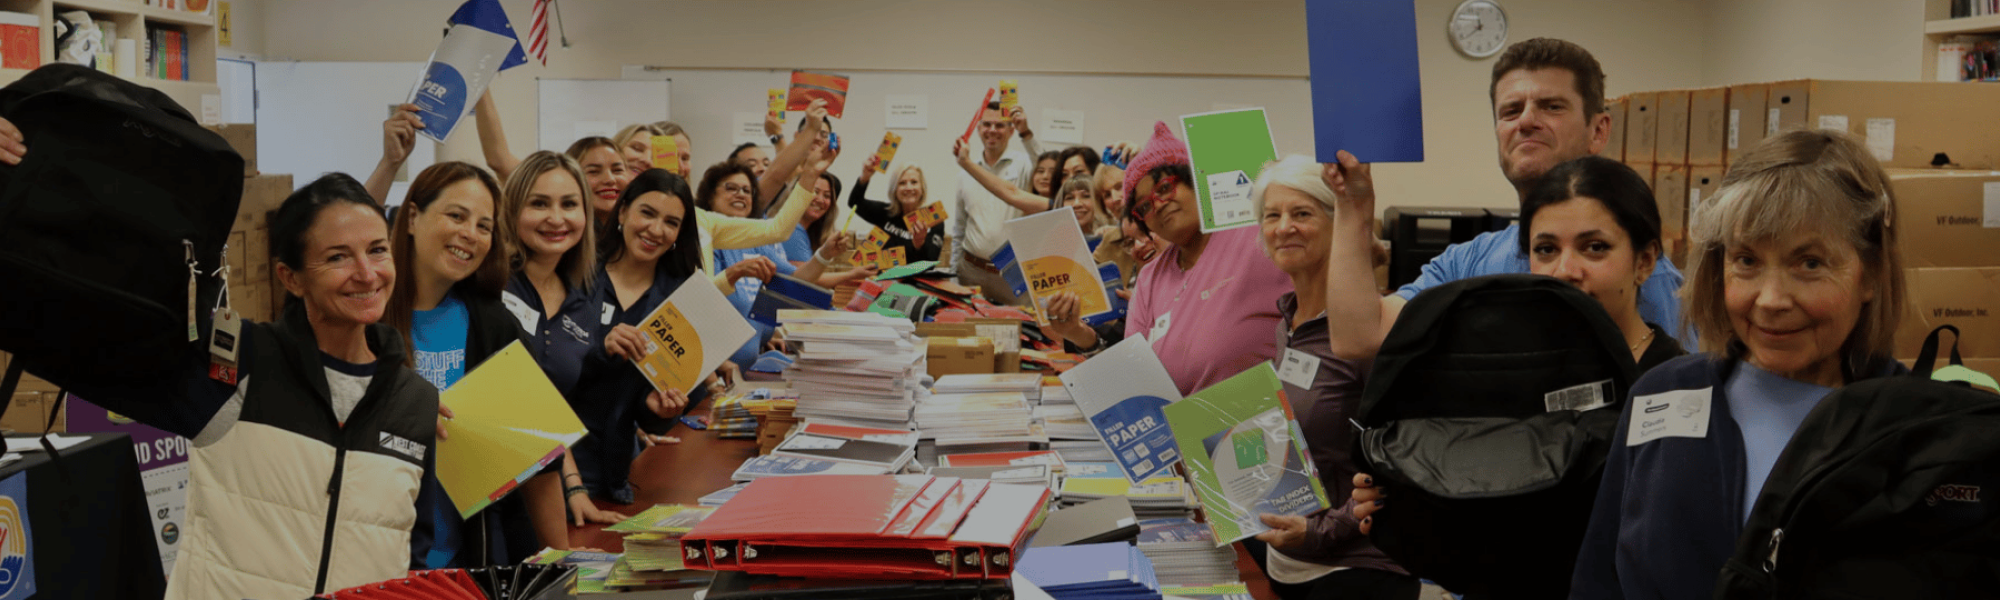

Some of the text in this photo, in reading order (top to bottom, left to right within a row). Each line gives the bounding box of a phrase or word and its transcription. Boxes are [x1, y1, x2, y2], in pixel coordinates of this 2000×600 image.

[219, 12, 228, 39] 4
[420, 80, 447, 99] PER
[1936, 215, 1946, 226] VF
[1032, 273, 1071, 291] PAPER
[1933, 308, 1943, 317] VF
[649, 319, 686, 358] PAPER
[413, 349, 465, 370] STUFF
[1109, 415, 1157, 447] PAPER
